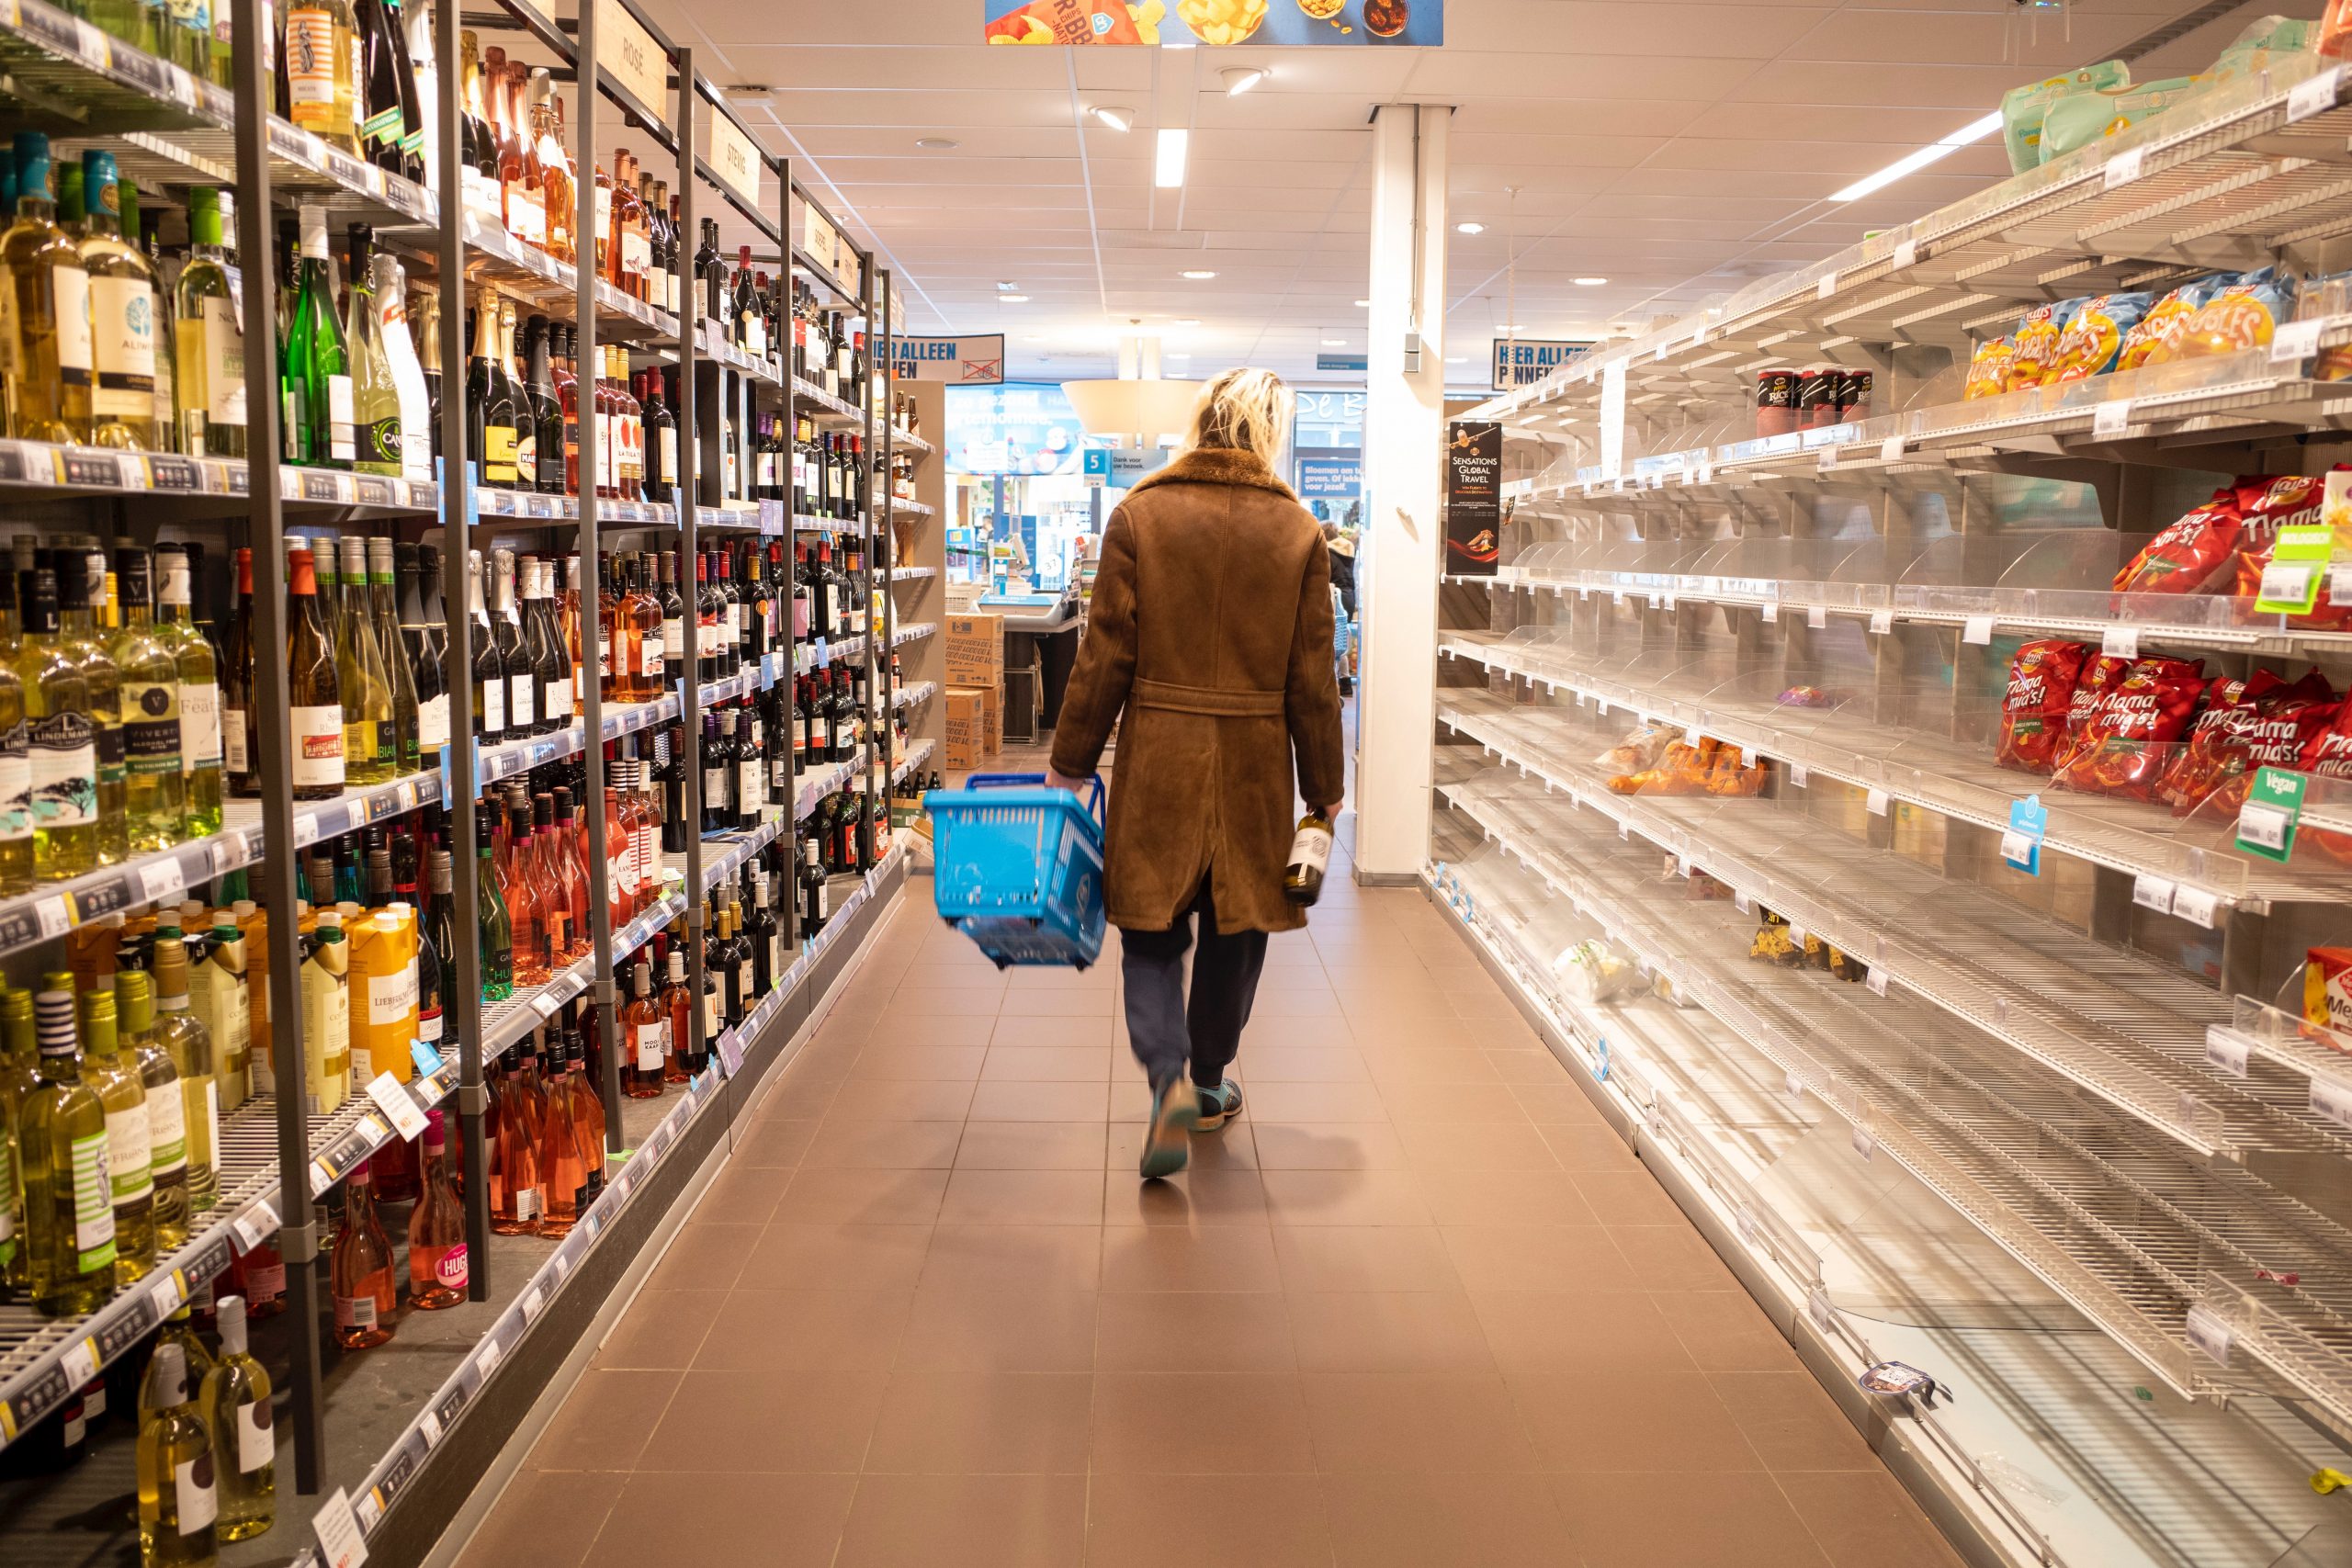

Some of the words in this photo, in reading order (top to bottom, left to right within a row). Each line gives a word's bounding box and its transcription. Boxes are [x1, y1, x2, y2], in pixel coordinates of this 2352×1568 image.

[623, 36, 644, 77] ROSÉ
[899, 342, 956, 360] ALLEEN
[1090, 455, 1100, 469] 5
[1453, 457, 1498, 466] SENSATIONS
[1305, 466, 1339, 474] Bloemen
[1458, 465, 1491, 475] GLOBAL
[1305, 475, 1330, 484] geven.
[1331, 474, 1341, 482] Of
[1460, 474, 1489, 483] TRAVEL
[1323, 482, 1348, 492] jezelf.
[2265, 770, 2298, 795] Vegan
